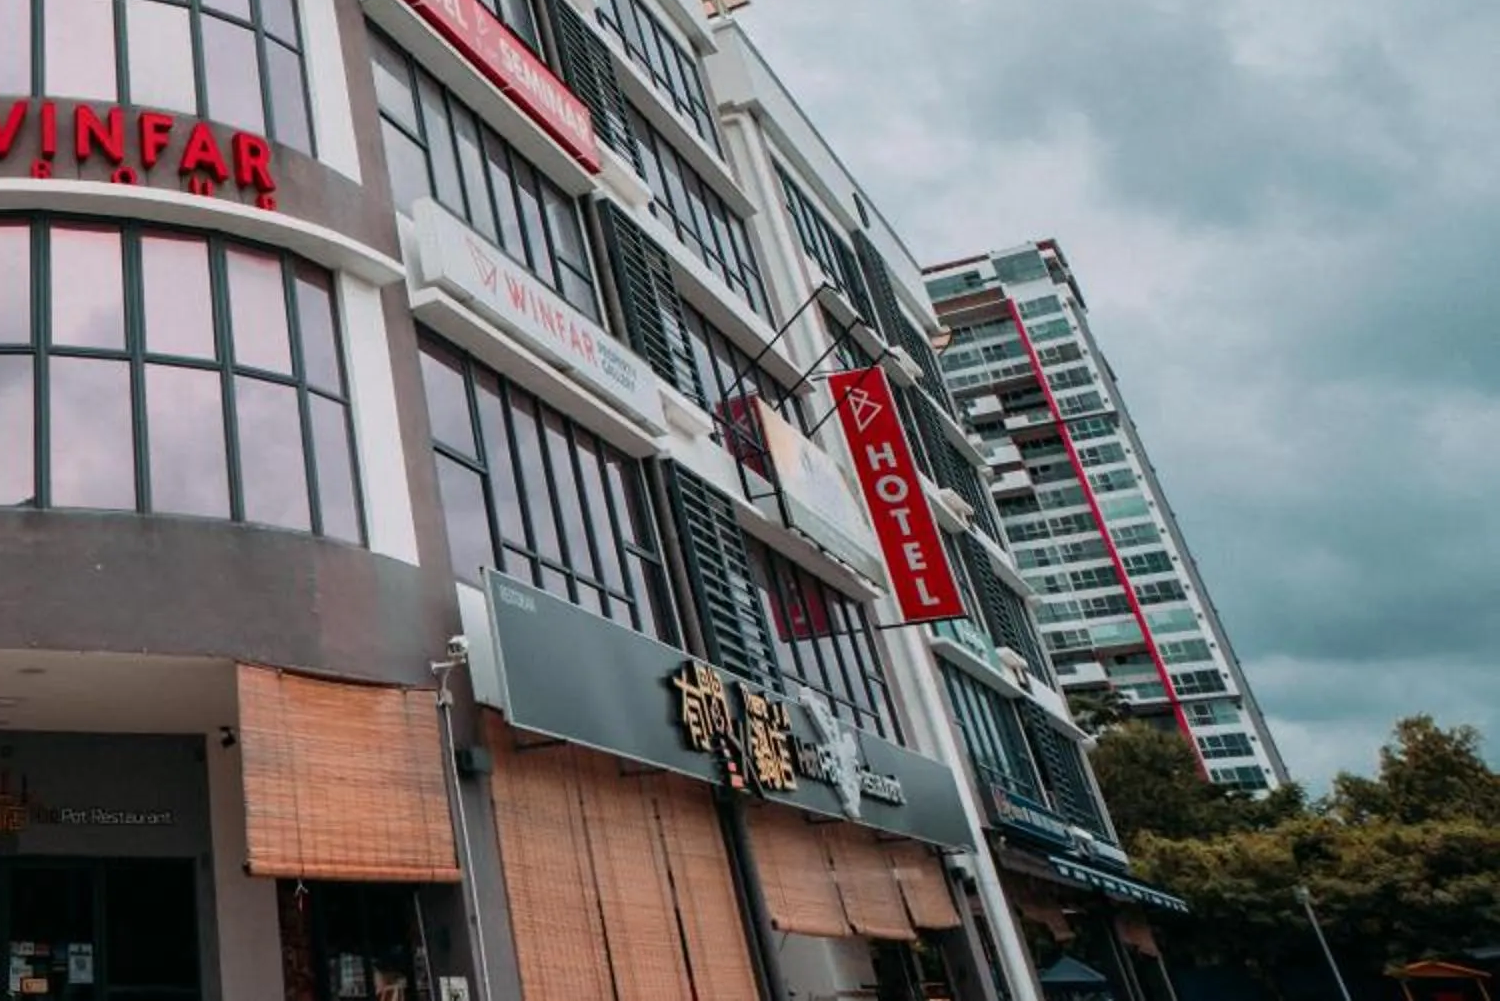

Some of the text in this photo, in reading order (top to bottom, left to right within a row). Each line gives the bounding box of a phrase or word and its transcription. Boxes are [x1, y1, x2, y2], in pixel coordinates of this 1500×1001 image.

[504, 269, 598, 369] WINFAR
[865, 441, 941, 607] HOTEL
[61, 808, 87, 824] Pot
[91, 808, 173, 825] Restaurant
